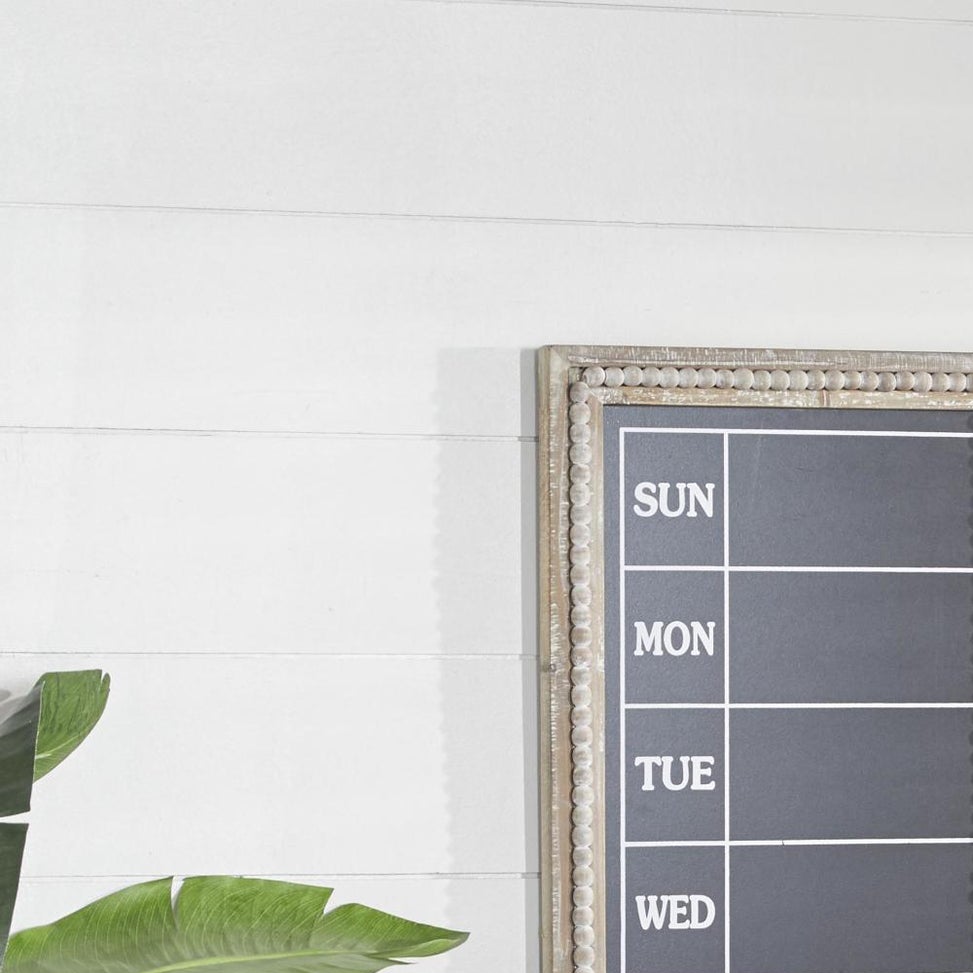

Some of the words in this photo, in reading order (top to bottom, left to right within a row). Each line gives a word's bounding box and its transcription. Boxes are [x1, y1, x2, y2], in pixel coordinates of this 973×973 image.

[633, 482, 716, 518] SUN
[634, 620, 716, 657] MON
[634, 755, 716, 791] TUE
[635, 894, 716, 931] WED
